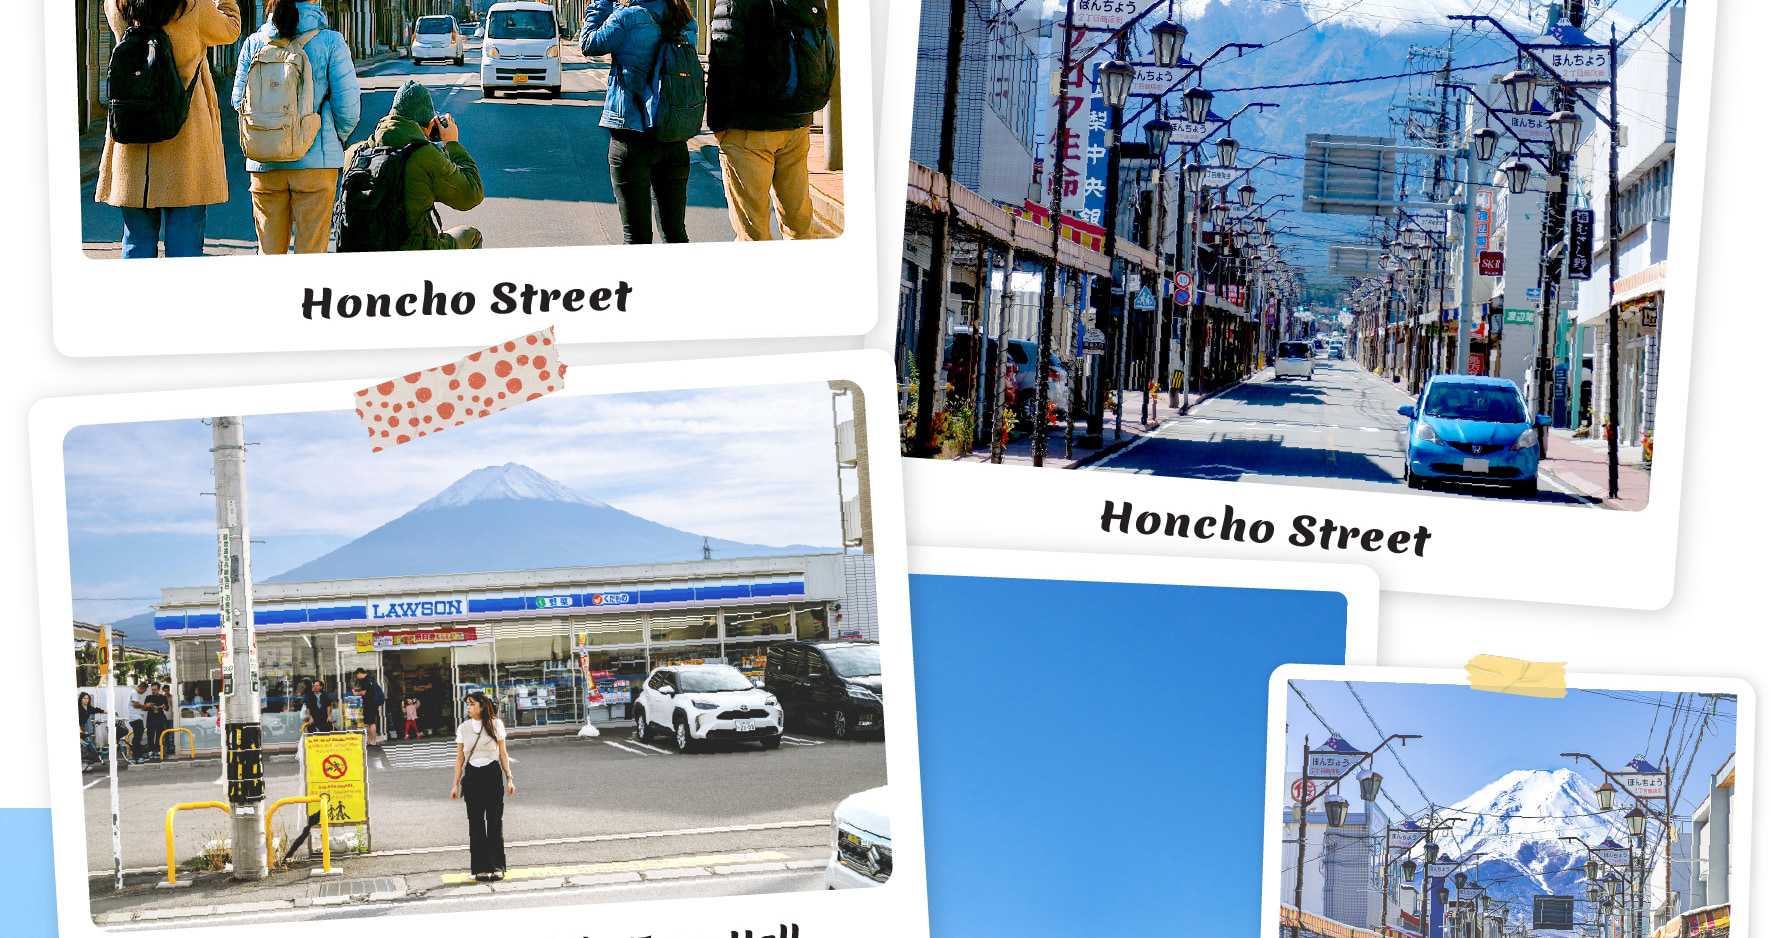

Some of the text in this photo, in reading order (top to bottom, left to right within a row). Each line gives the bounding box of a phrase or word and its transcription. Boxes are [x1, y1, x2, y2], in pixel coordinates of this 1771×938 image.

[1552, 53, 1606, 67] ほんちょう
[1132, 70, 1173, 82] んちょう
[1179, 276, 1189, 285] 40
[372, 599, 463, 619] LAWSON
[1312, 757, 1350, 767] ほんちょう
[1627, 777, 1663, 787] ほんちょう
